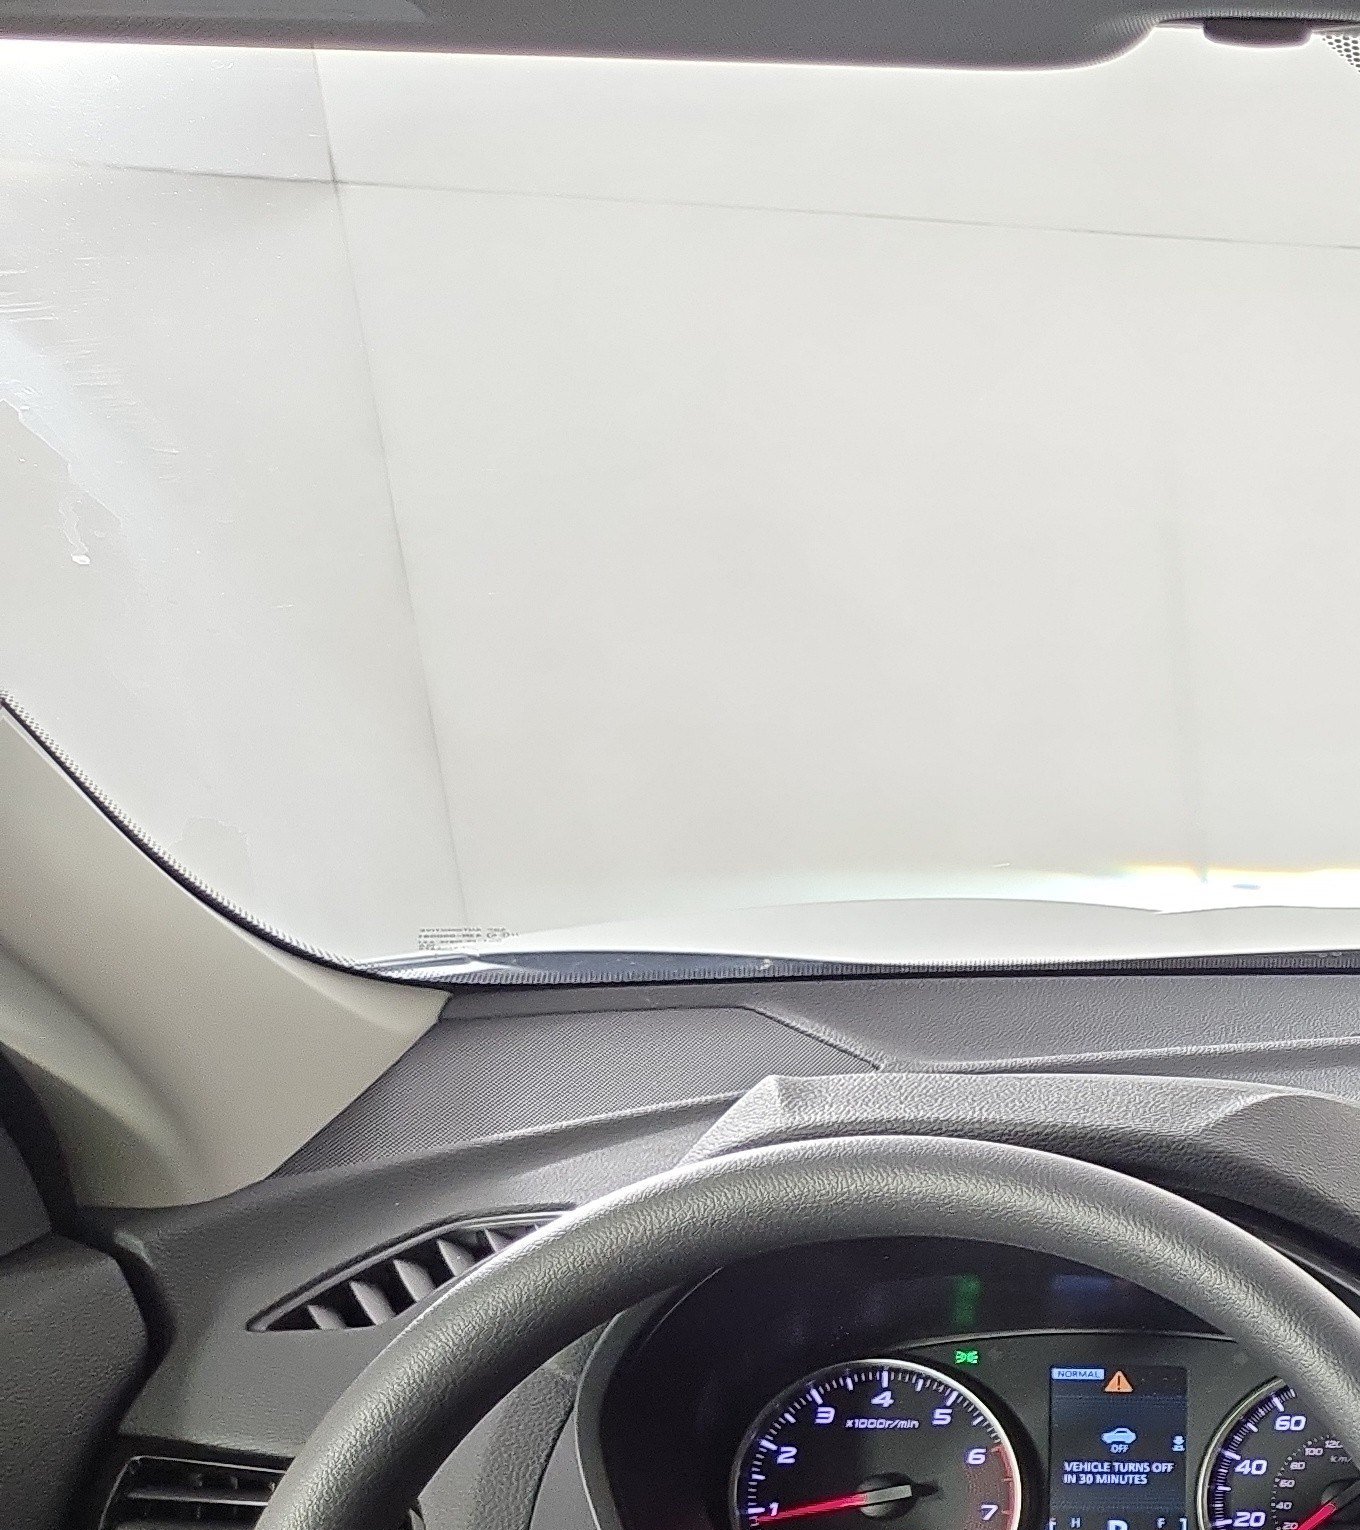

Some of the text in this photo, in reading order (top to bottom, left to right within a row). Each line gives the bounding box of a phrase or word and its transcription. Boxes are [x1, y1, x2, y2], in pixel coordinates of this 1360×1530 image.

[1057, 1370, 1100, 1379] NORMAL
[871, 1391, 894, 1407] 4
[815, 1407, 835, 1425] 3
[932, 1409, 952, 1425] 5
[1274, 1415, 1306, 1431] 60
[1110, 1444, 1130, 1453] OFF
[1304, 1447, 1323, 1456] 100
[776, 1447, 797, 1464] 2
[967, 1448, 987, 1464] 6
[1064, 1462, 1175, 1473] VEHICLE TURNS OFF
[1234, 1460, 1268, 1475] 40
[1290, 1461, 1306, 1470] 80
[1063, 1474, 1148, 1485] IN 30 MINUTES
[1278, 1479, 1295, 1488] 60
[769, 1502, 779, 1517] 1
[1276, 1502, 1292, 1510] 40
[980, 1504, 998, 1521] 7
[1070, 1518, 1081, 1529] H
[1157, 1519, 1166, 1529] F
[1233, 1511, 1266, 1527] 20
[1282, 1522, 1299, 1530] 20
